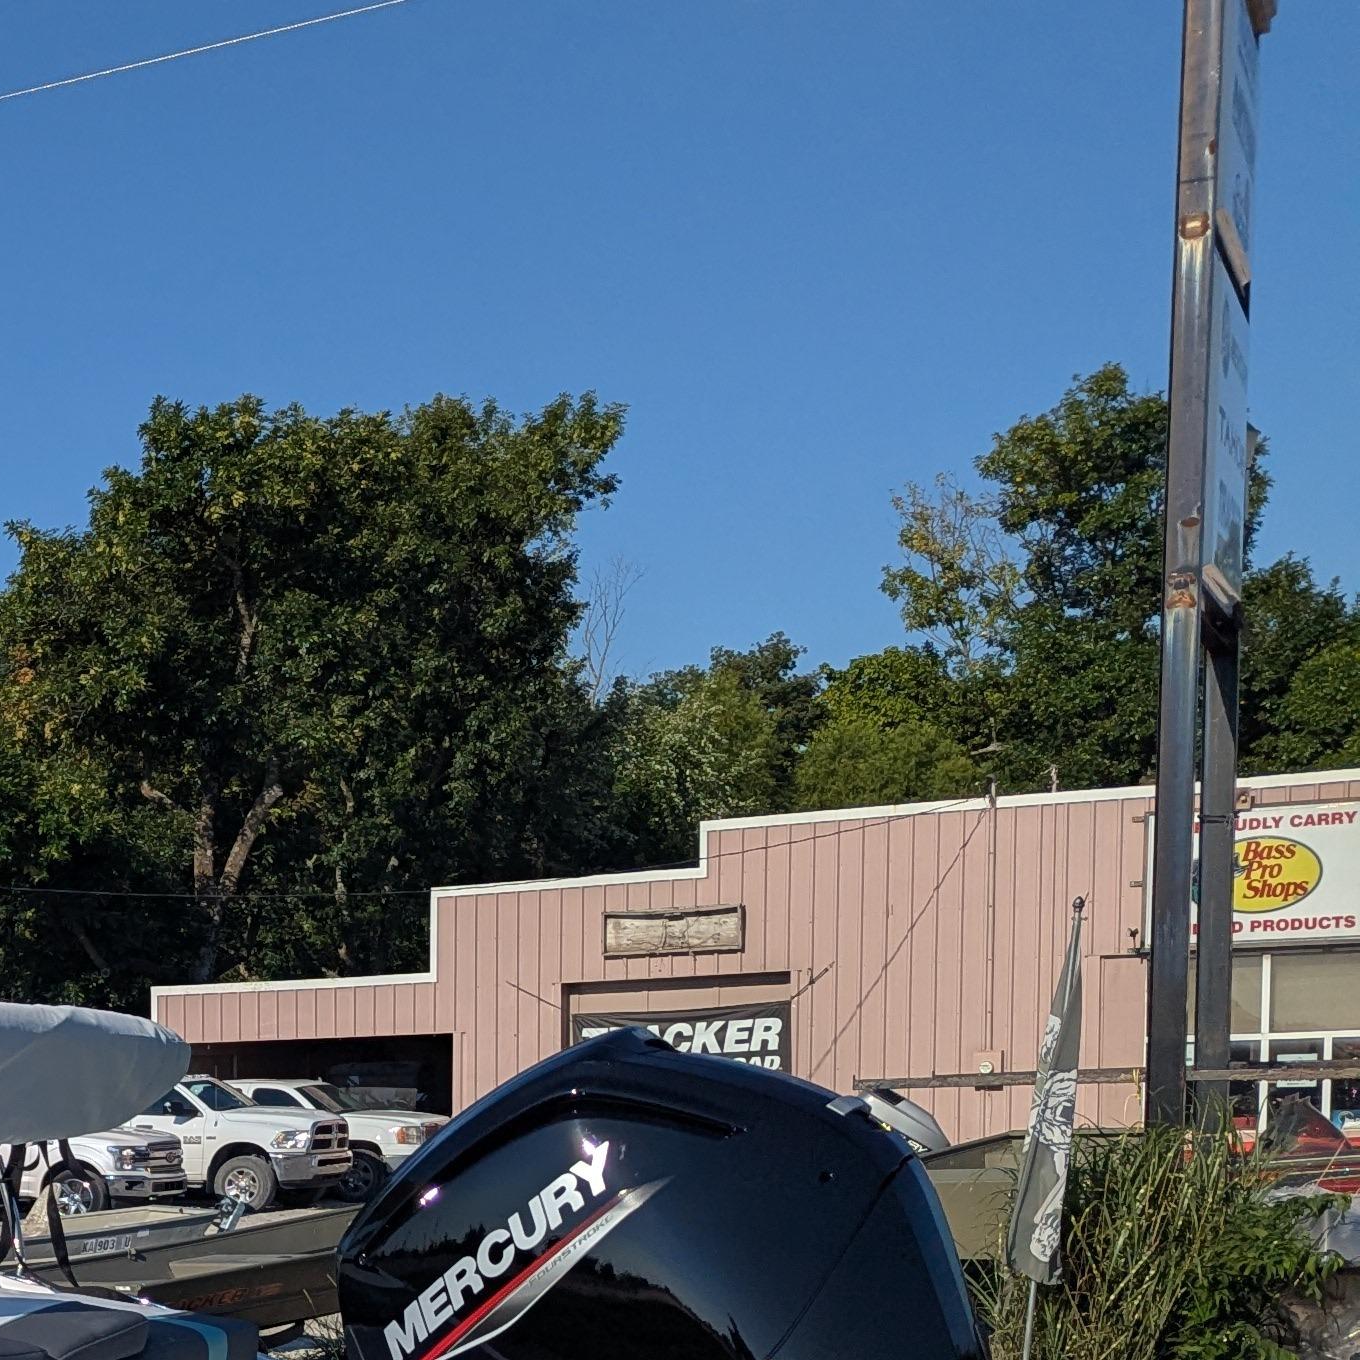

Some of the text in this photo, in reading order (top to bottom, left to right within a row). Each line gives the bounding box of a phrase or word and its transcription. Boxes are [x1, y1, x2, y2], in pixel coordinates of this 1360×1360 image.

[1289, 811, 1358, 828] CARRY
[1242, 841, 1298, 862] Bass
[1243, 860, 1283, 881] Pro
[1242, 878, 1310, 902] Shops
[1250, 915, 1356, 933] PRODUCTS
[98, 1238, 116, 1251] 903
